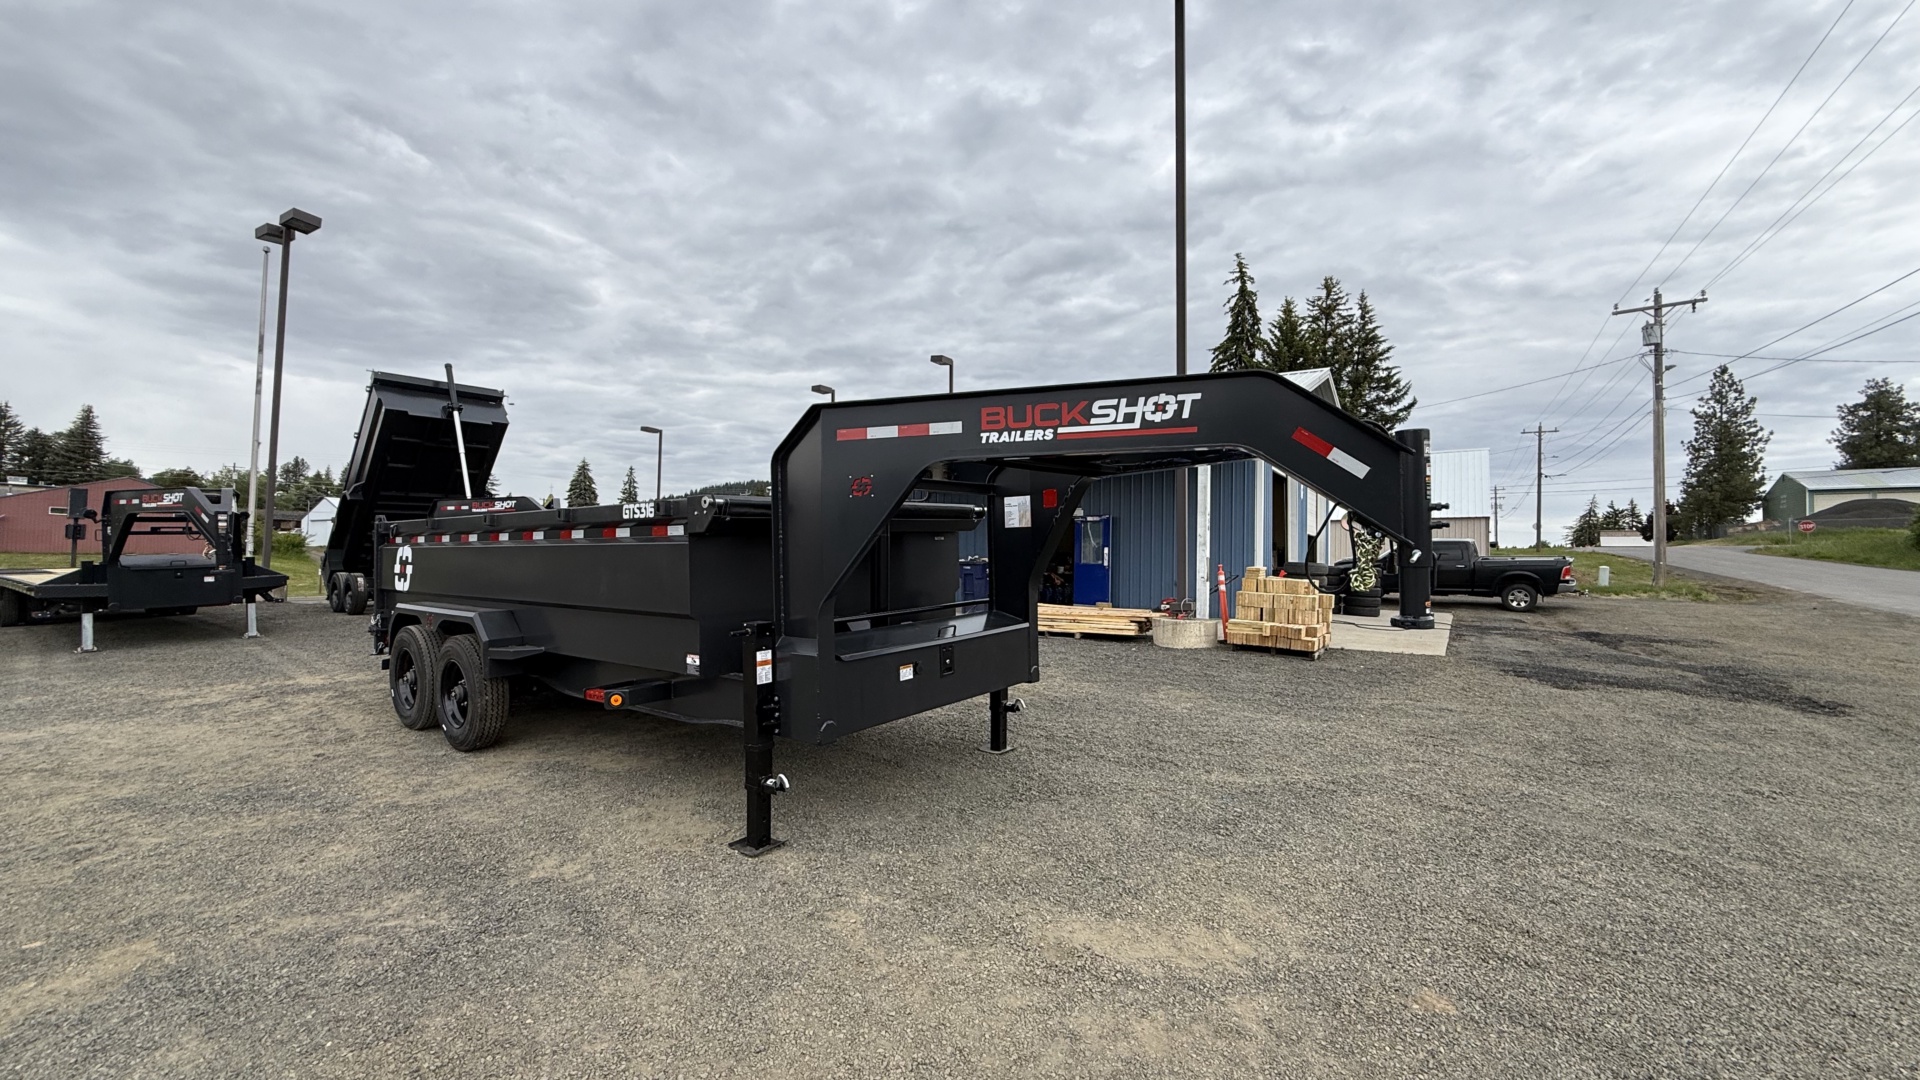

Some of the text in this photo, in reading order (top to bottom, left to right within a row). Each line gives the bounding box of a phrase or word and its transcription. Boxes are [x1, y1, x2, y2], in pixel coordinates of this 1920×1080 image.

[980, 392, 1202, 430] BUCKSHOT
[980, 428, 1054, 444] TRAILERS
[142, 492, 185, 504] BUCKSHOT
[471, 500, 517, 509] BUCKSHOT
[622, 502, 655, 519] GTS316
